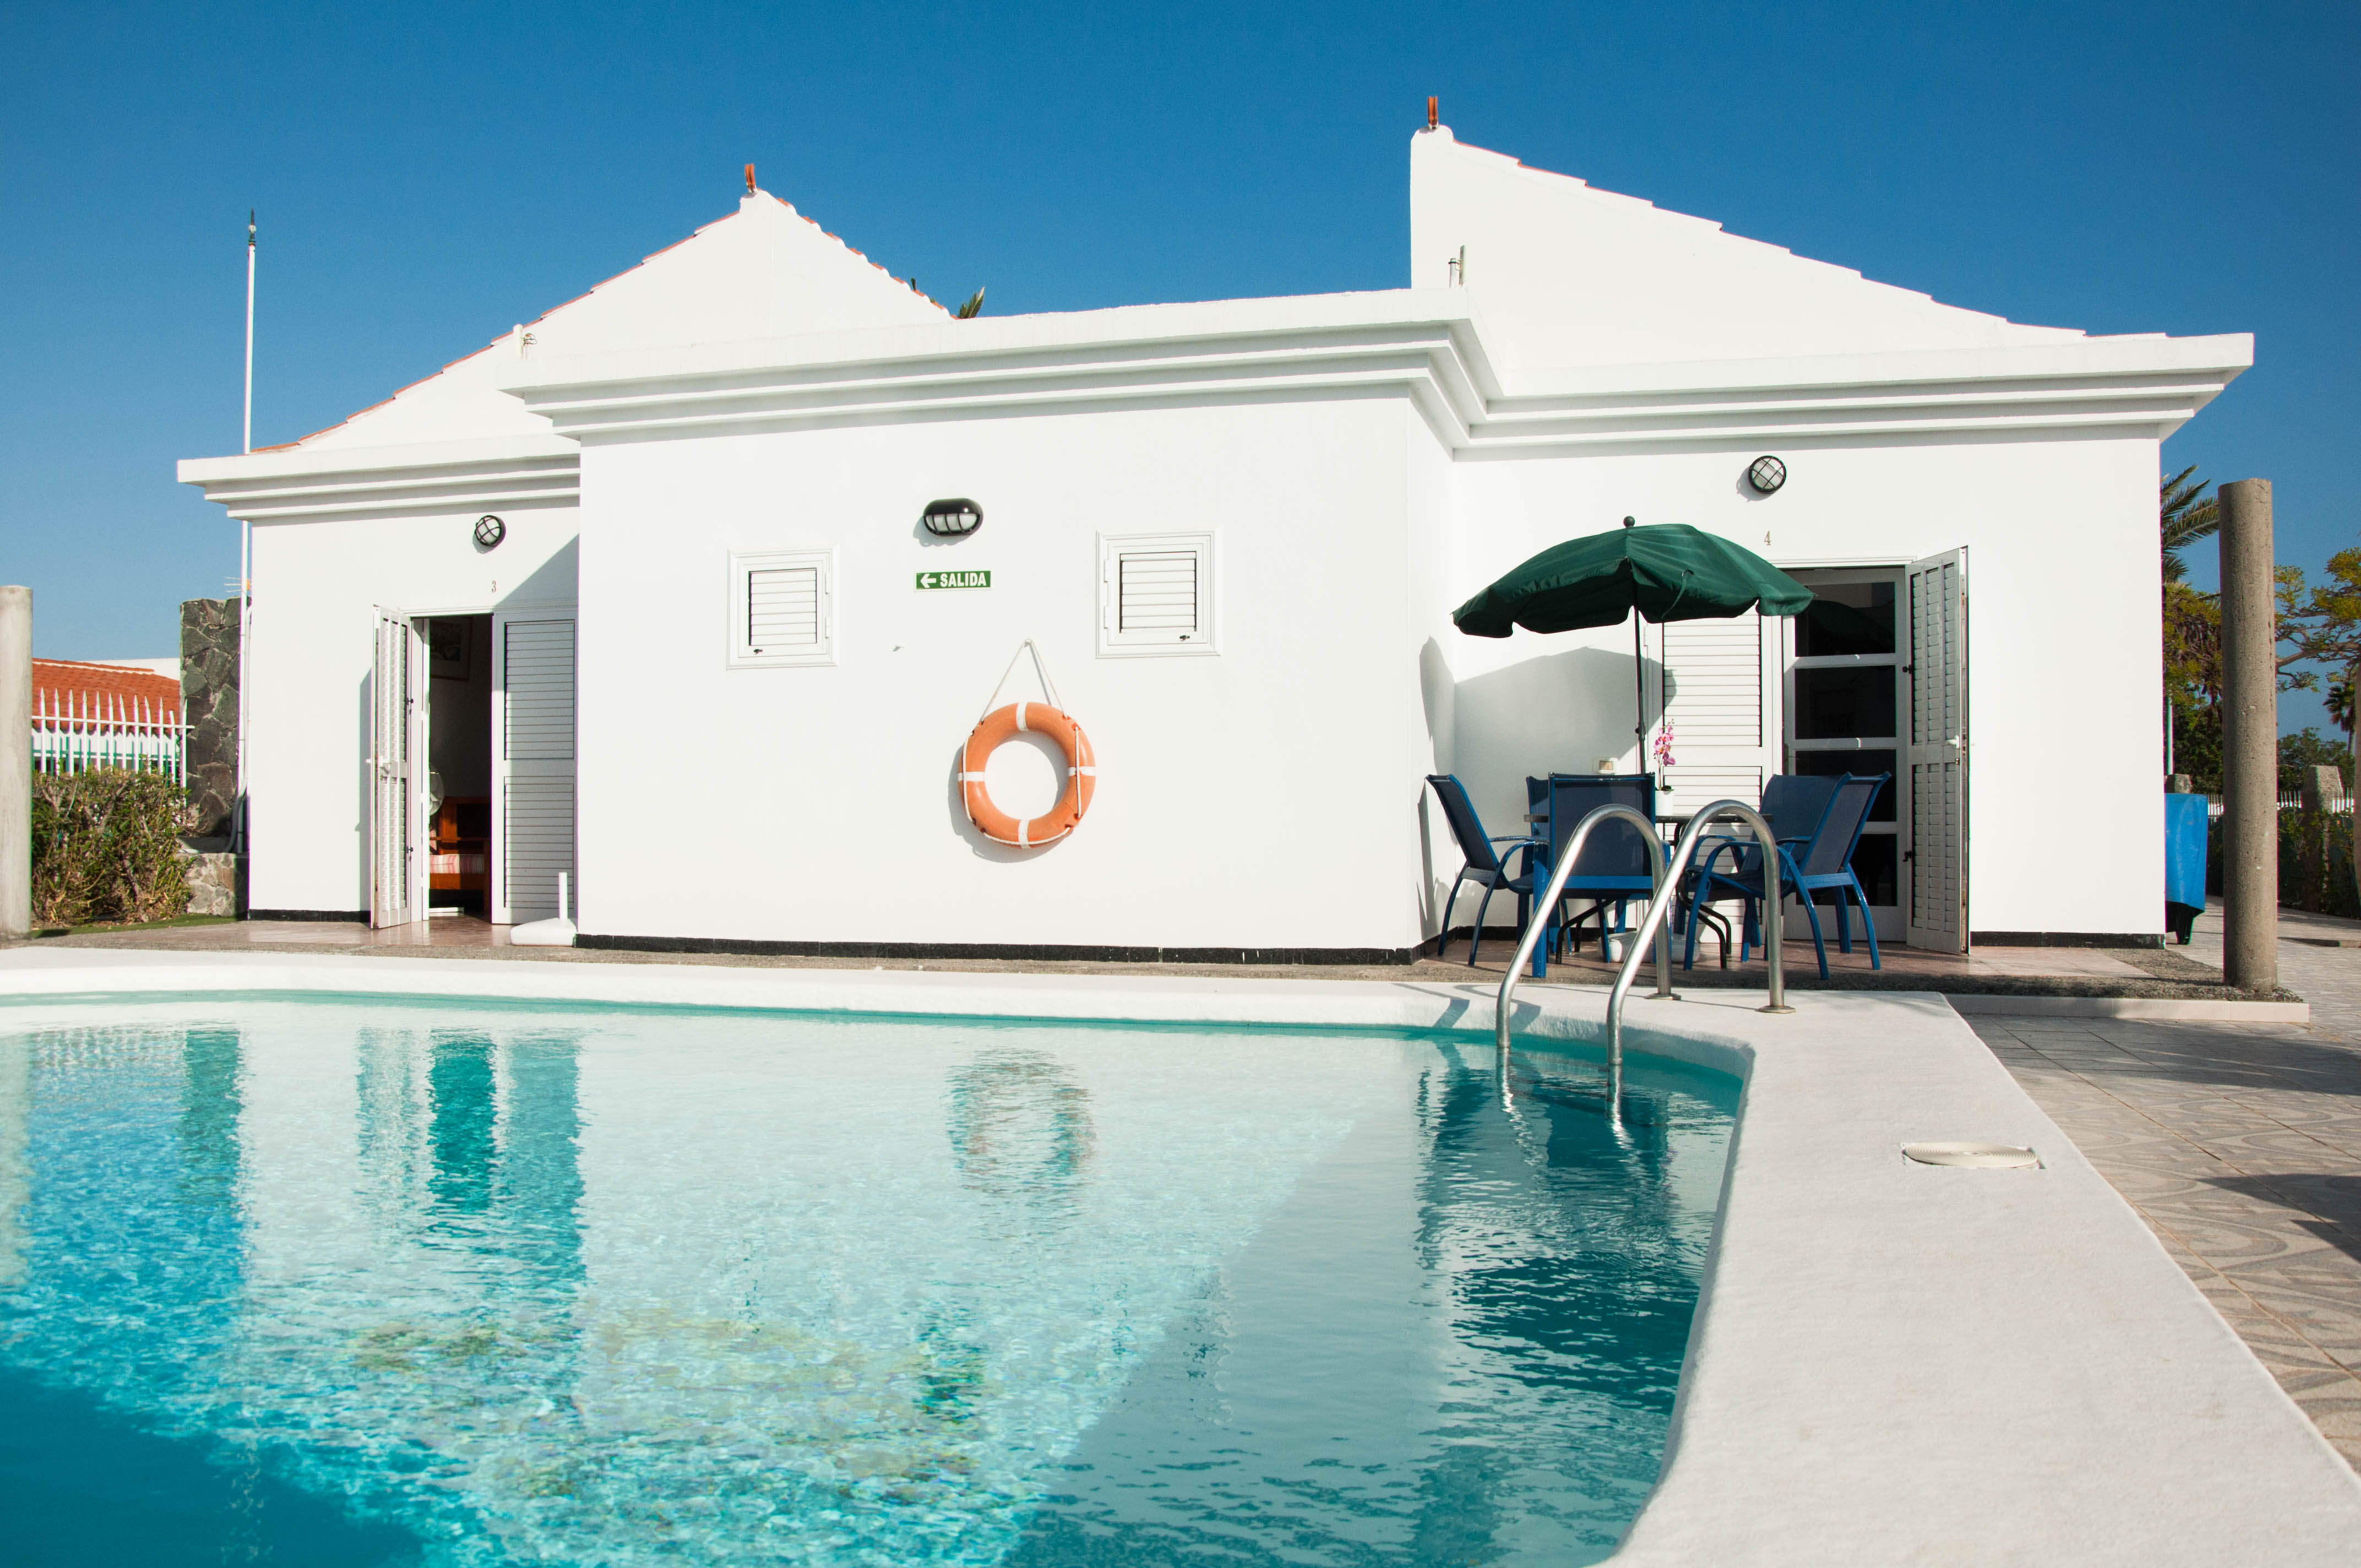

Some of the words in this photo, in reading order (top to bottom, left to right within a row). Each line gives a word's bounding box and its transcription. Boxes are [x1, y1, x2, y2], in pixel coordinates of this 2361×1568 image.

[1764, 530, 1771, 546] 4
[491, 580, 497, 593] 3
[940, 572, 987, 587] SALIDA
